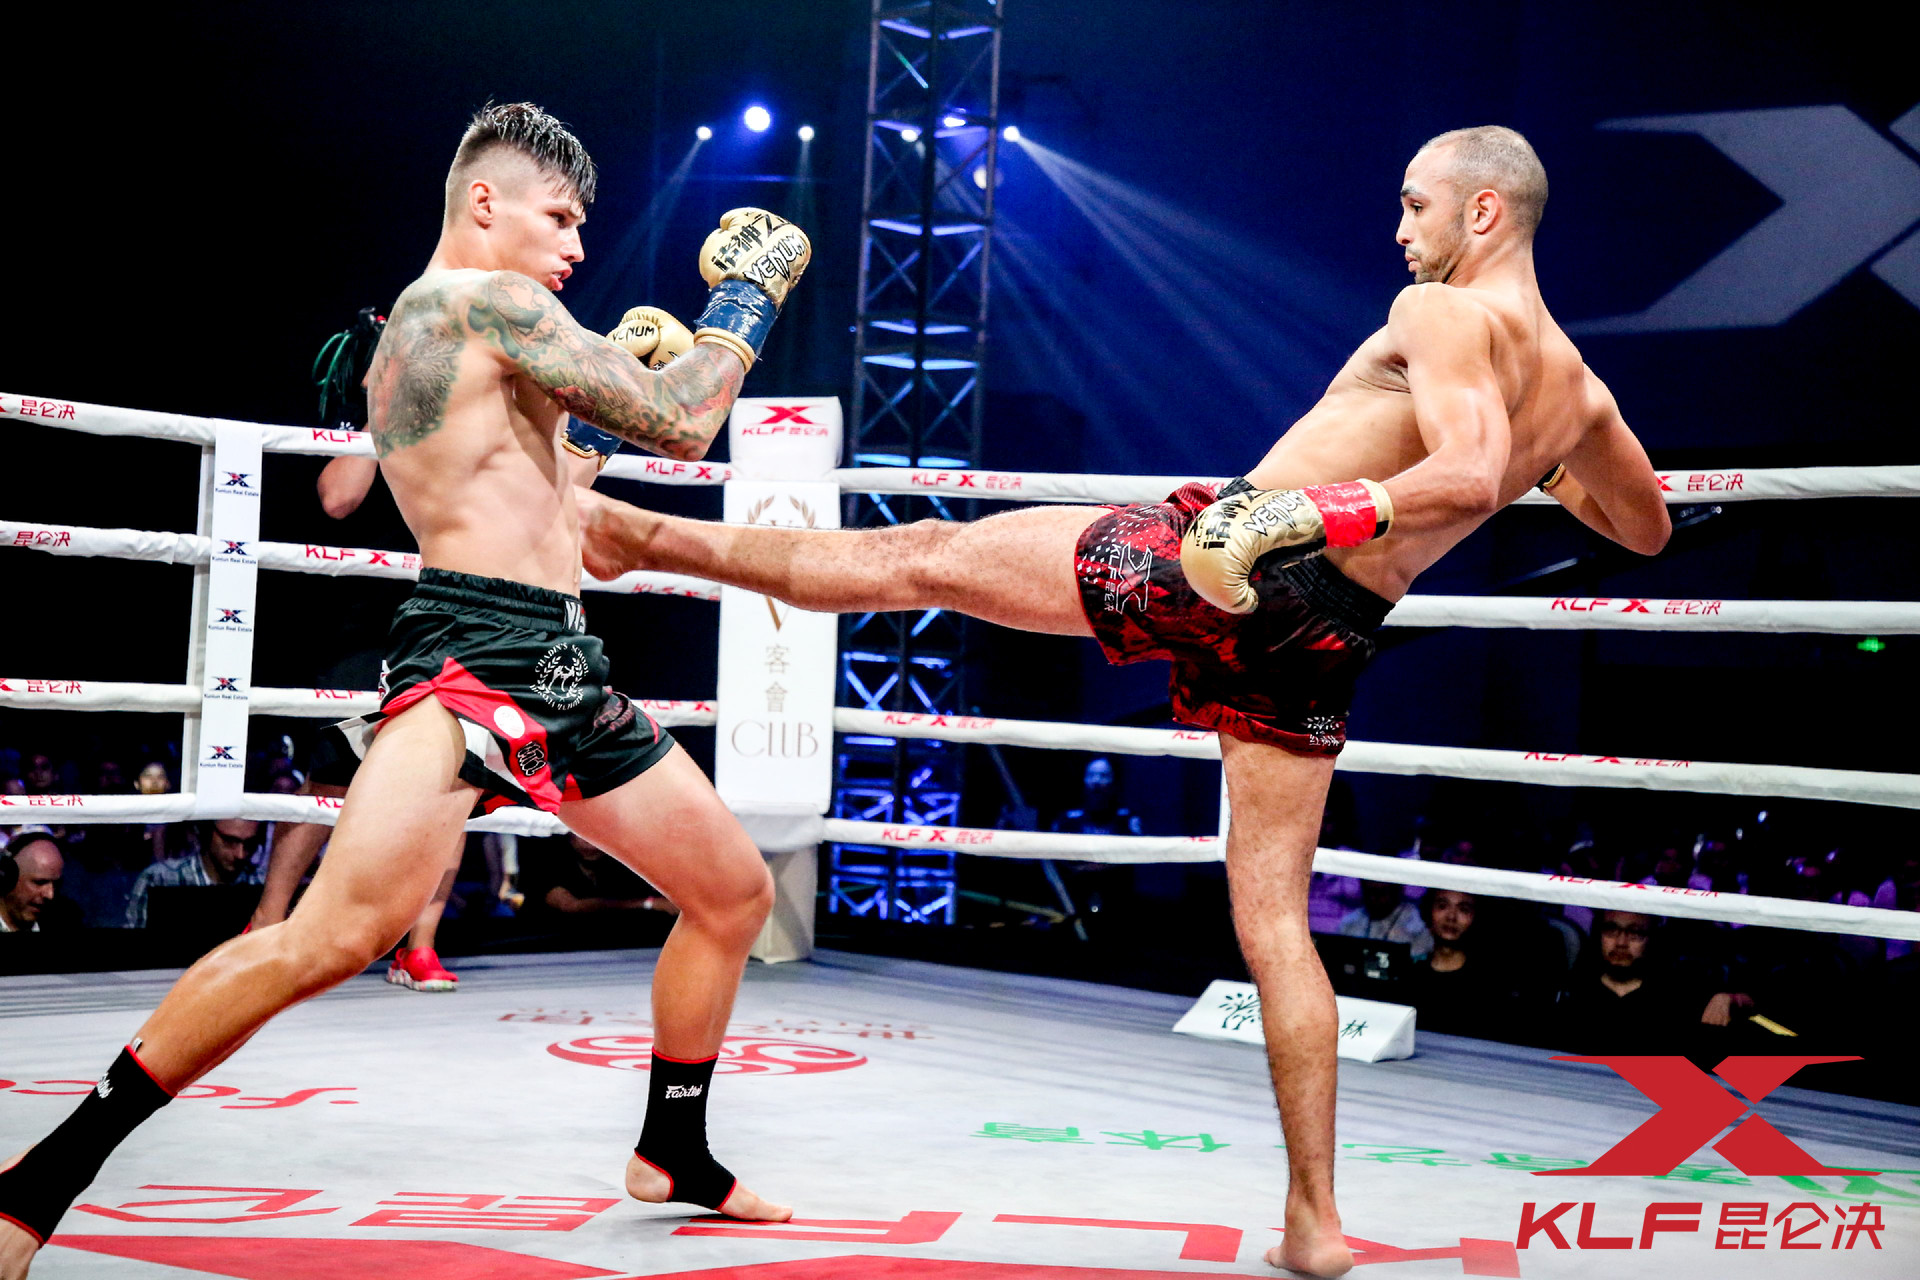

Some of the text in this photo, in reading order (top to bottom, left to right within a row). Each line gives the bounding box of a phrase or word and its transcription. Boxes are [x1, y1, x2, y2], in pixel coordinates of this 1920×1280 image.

[743, 232, 806, 287] VENUM
[20, 400, 76, 420] 昆仑决
[312, 428, 362, 444] KLF
[742, 427, 785, 437] KLF
[645, 461, 686, 476] KLF
[911, 473, 949, 486] KLF
[1688, 473, 1744, 492] 昆仑决
[1242, 490, 1305, 536] VENUM
[305, 544, 356, 561] KLF
[1108, 543, 1121, 580] KLF
[1552, 597, 1612, 613] KLF
[882, 828, 921, 842] KLF
